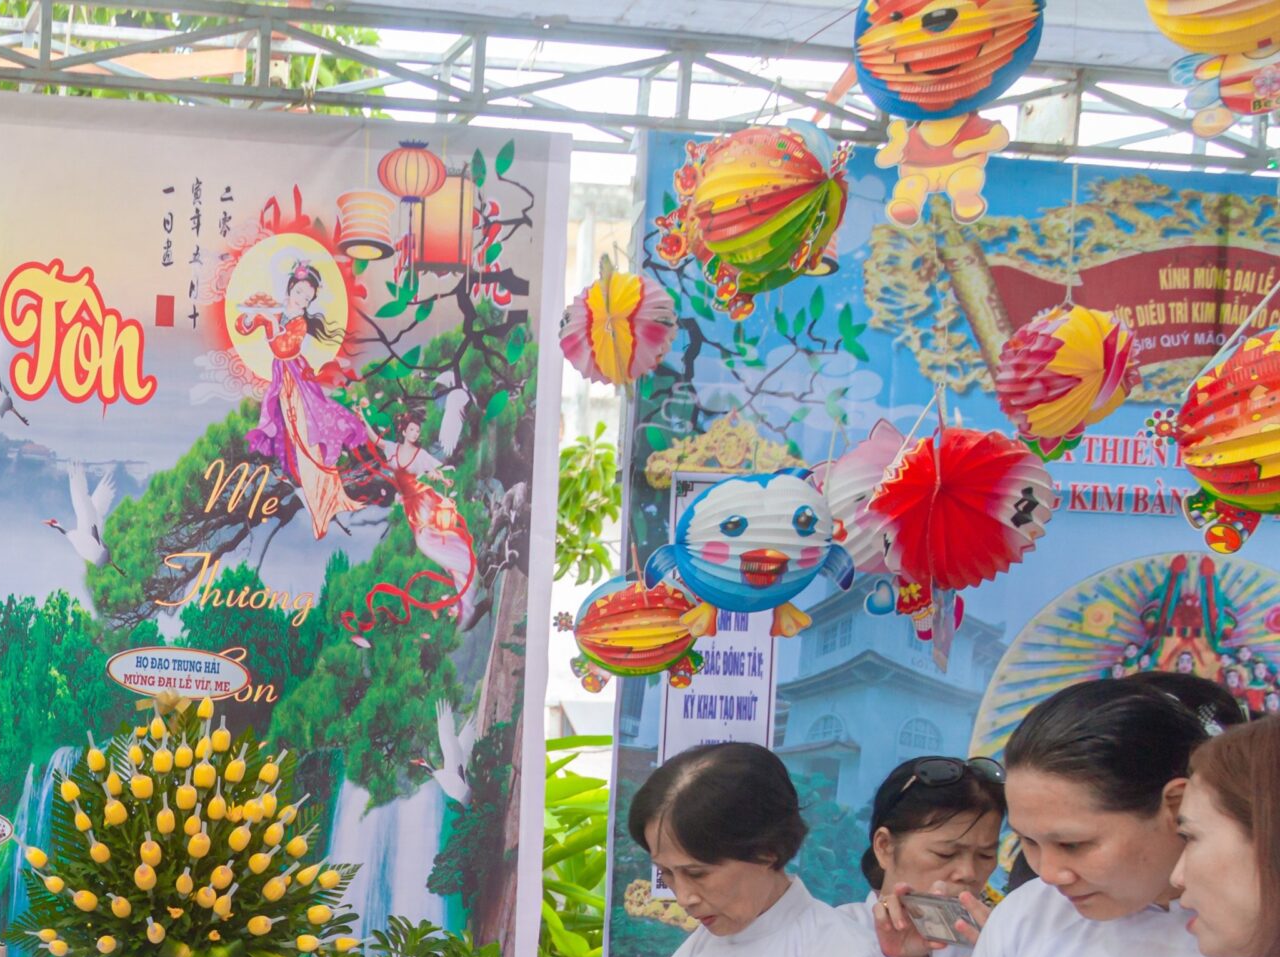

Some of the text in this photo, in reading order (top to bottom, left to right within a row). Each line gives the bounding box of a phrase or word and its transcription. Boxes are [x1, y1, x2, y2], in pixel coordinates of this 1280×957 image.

[1159, 264, 1190, 290] KÍNH
[1233, 269, 1256, 296] ĐẠI
[1257, 267, 1275, 295] LỄ
[1115, 304, 1134, 328] ỨC
[1169, 298, 1189, 323] TRÌ
[1191, 302, 1216, 323] KIM
[0, 258, 157, 405] Tôn
[204, 459, 279, 523] Mẹ
[1069, 484, 1126, 512] KIM
[154, 552, 315, 627] Thương
[136, 656, 221, 674] HỌ ĐẠO TRUNG HẢI
[722, 646, 745, 676] ĐÔNG
[123, 672, 155, 686] MỪNG
[158, 677, 177, 690] ĐẠI
[179, 675, 192, 689] LỄ
[696, 695, 718, 719] KHAI
[720, 695, 735, 726] TẠO
